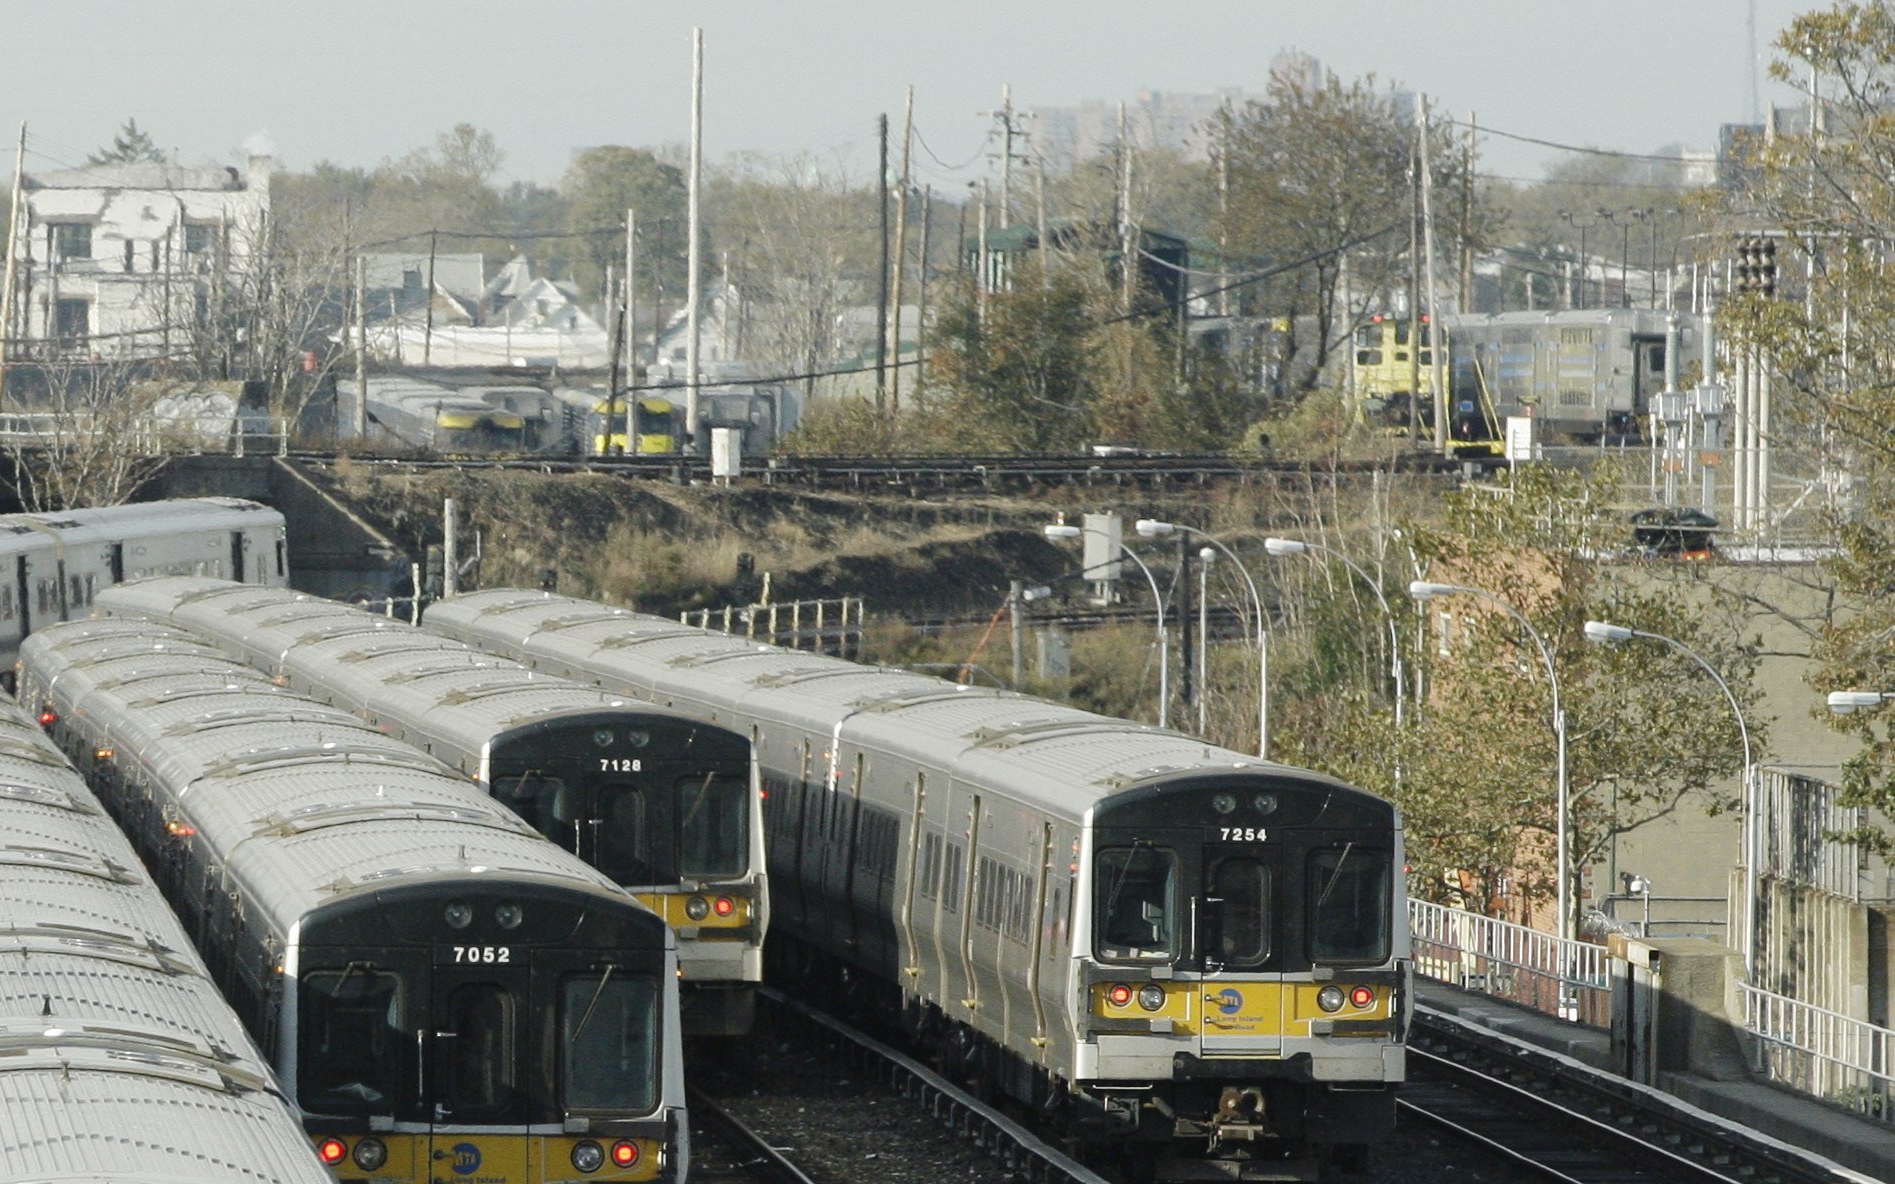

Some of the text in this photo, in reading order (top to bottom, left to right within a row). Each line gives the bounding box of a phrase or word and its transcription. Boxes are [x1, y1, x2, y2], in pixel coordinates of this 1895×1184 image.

[600, 758, 641, 771] 7128
[1220, 827, 1267, 841] 7254
[453, 946, 510, 962] 7052
